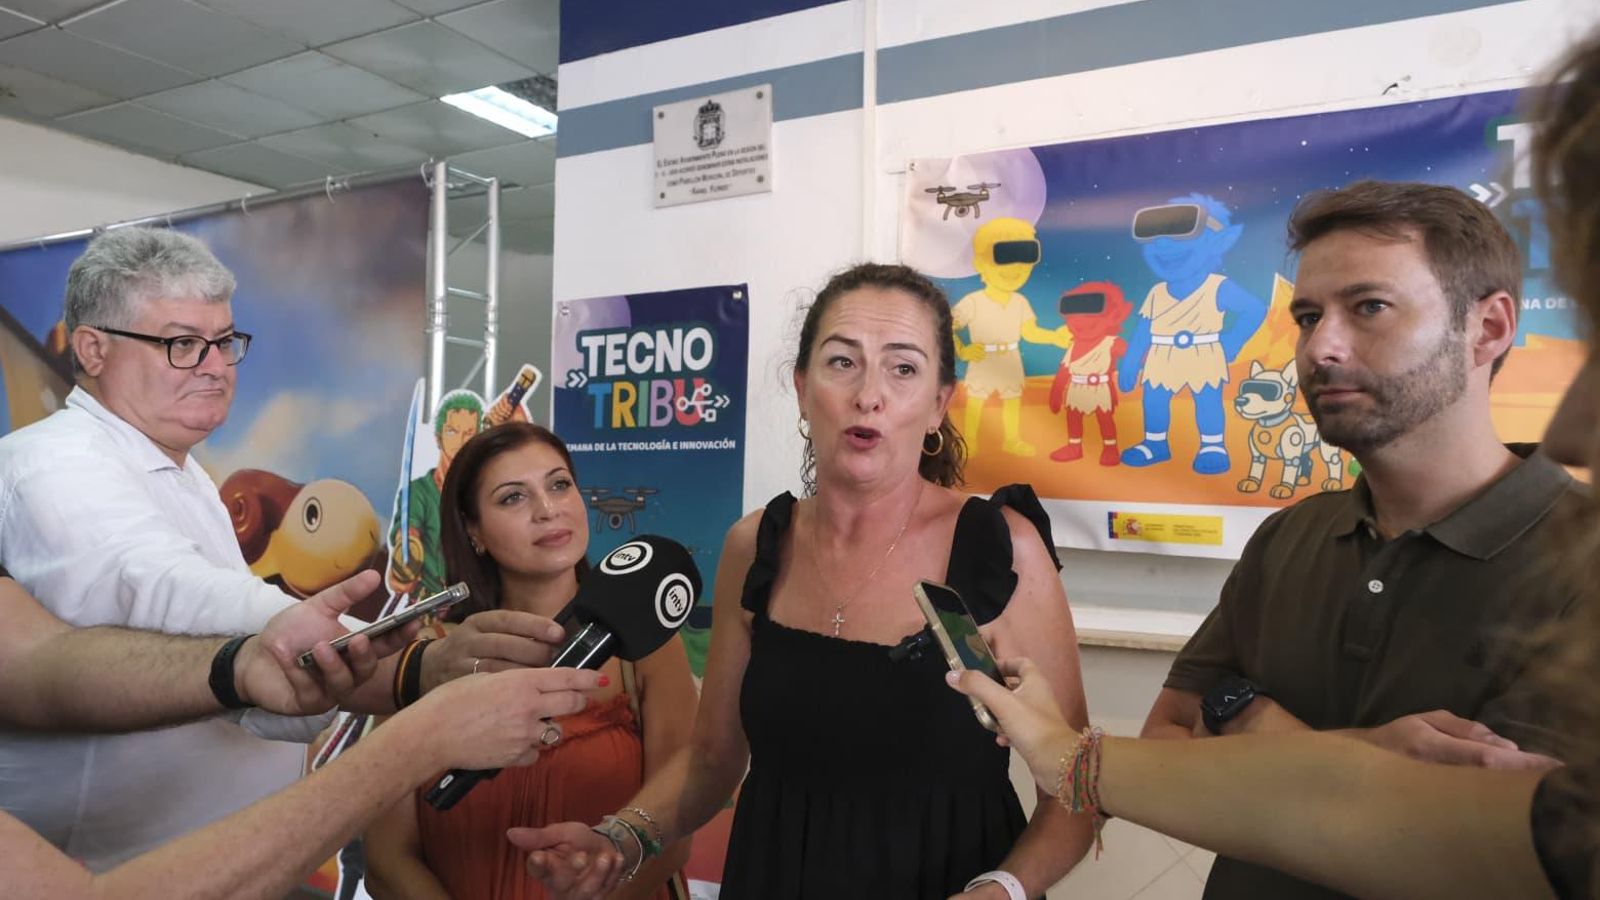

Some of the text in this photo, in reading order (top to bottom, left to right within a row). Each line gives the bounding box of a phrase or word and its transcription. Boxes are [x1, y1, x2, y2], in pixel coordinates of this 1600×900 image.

[582, 327, 713, 377] TECNO
[588, 378, 706, 429] TRIBU
[566, 437, 736, 452] EMANA DE LA TECNOLOGÍA E INNOVACIÓN
[668, 588, 683, 612] intv
